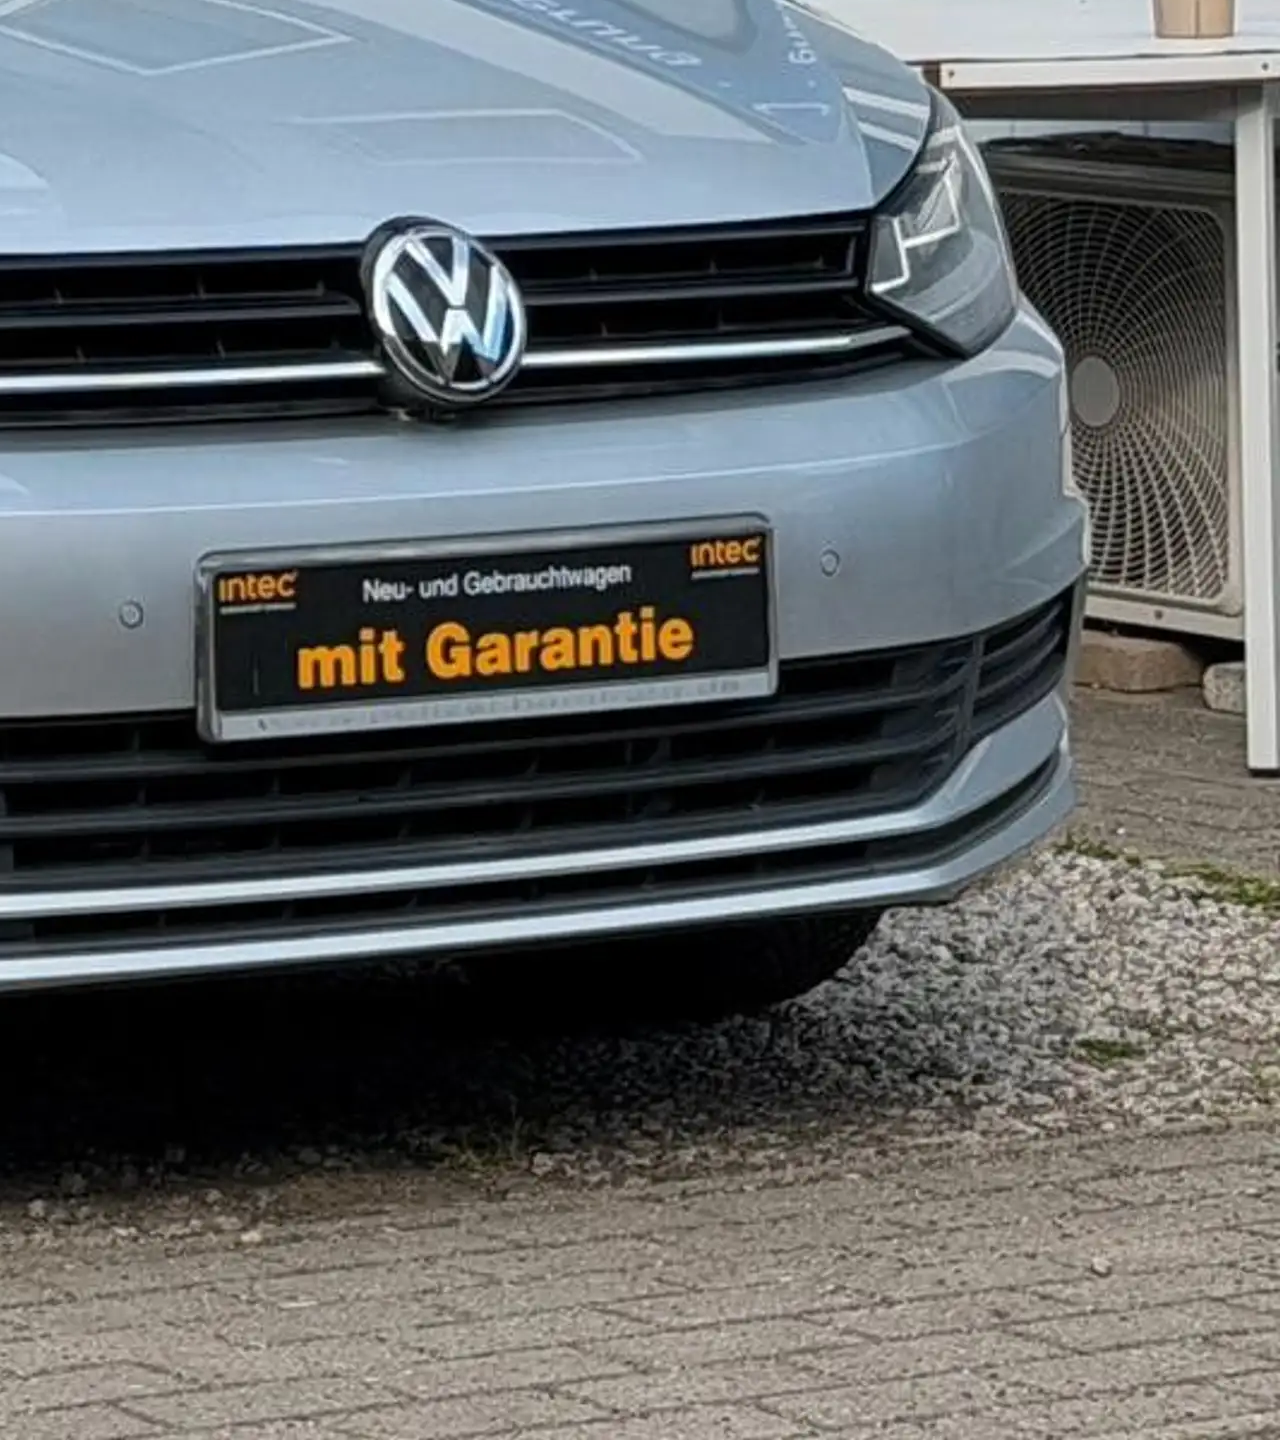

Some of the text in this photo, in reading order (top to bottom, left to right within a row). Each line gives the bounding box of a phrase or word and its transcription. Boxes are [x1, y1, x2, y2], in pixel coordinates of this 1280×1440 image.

[691, 536, 761, 567] intec
[219, 569, 298, 602] intec
[362, 564, 632, 603] Neu- und Gebrauchtwagen
[297, 606, 695, 690] mit Garantie
